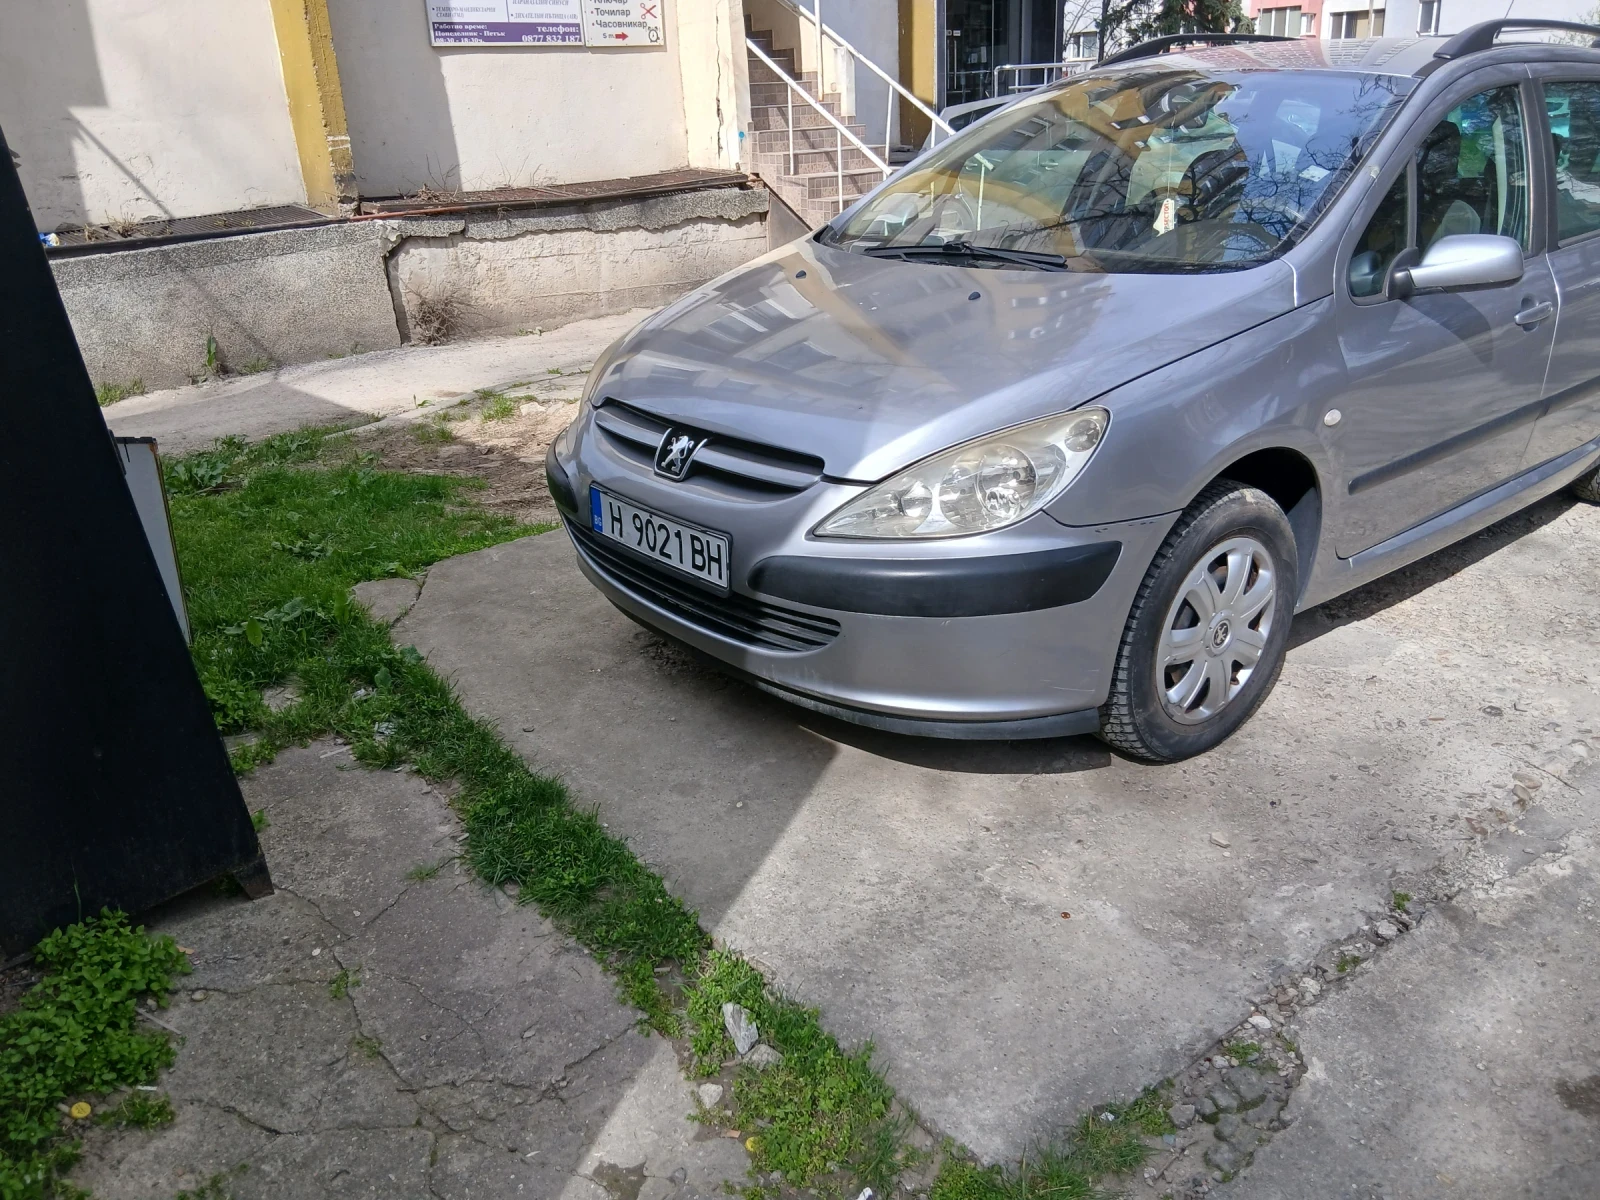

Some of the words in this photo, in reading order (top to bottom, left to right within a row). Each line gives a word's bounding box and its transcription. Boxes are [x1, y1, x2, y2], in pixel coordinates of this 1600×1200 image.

[594, 7, 631, 17] Точилар
[595, 20, 648, 29] Часовникар
[536, 25, 579, 34] телефон:
[522, 35, 544, 43] 0877
[546, 35, 562, 43] 832
[565, 35, 580, 43] 187
[594, 514, 602, 527] BG
[632, 512, 684, 565] 9021
[689, 533, 723, 581] BH
